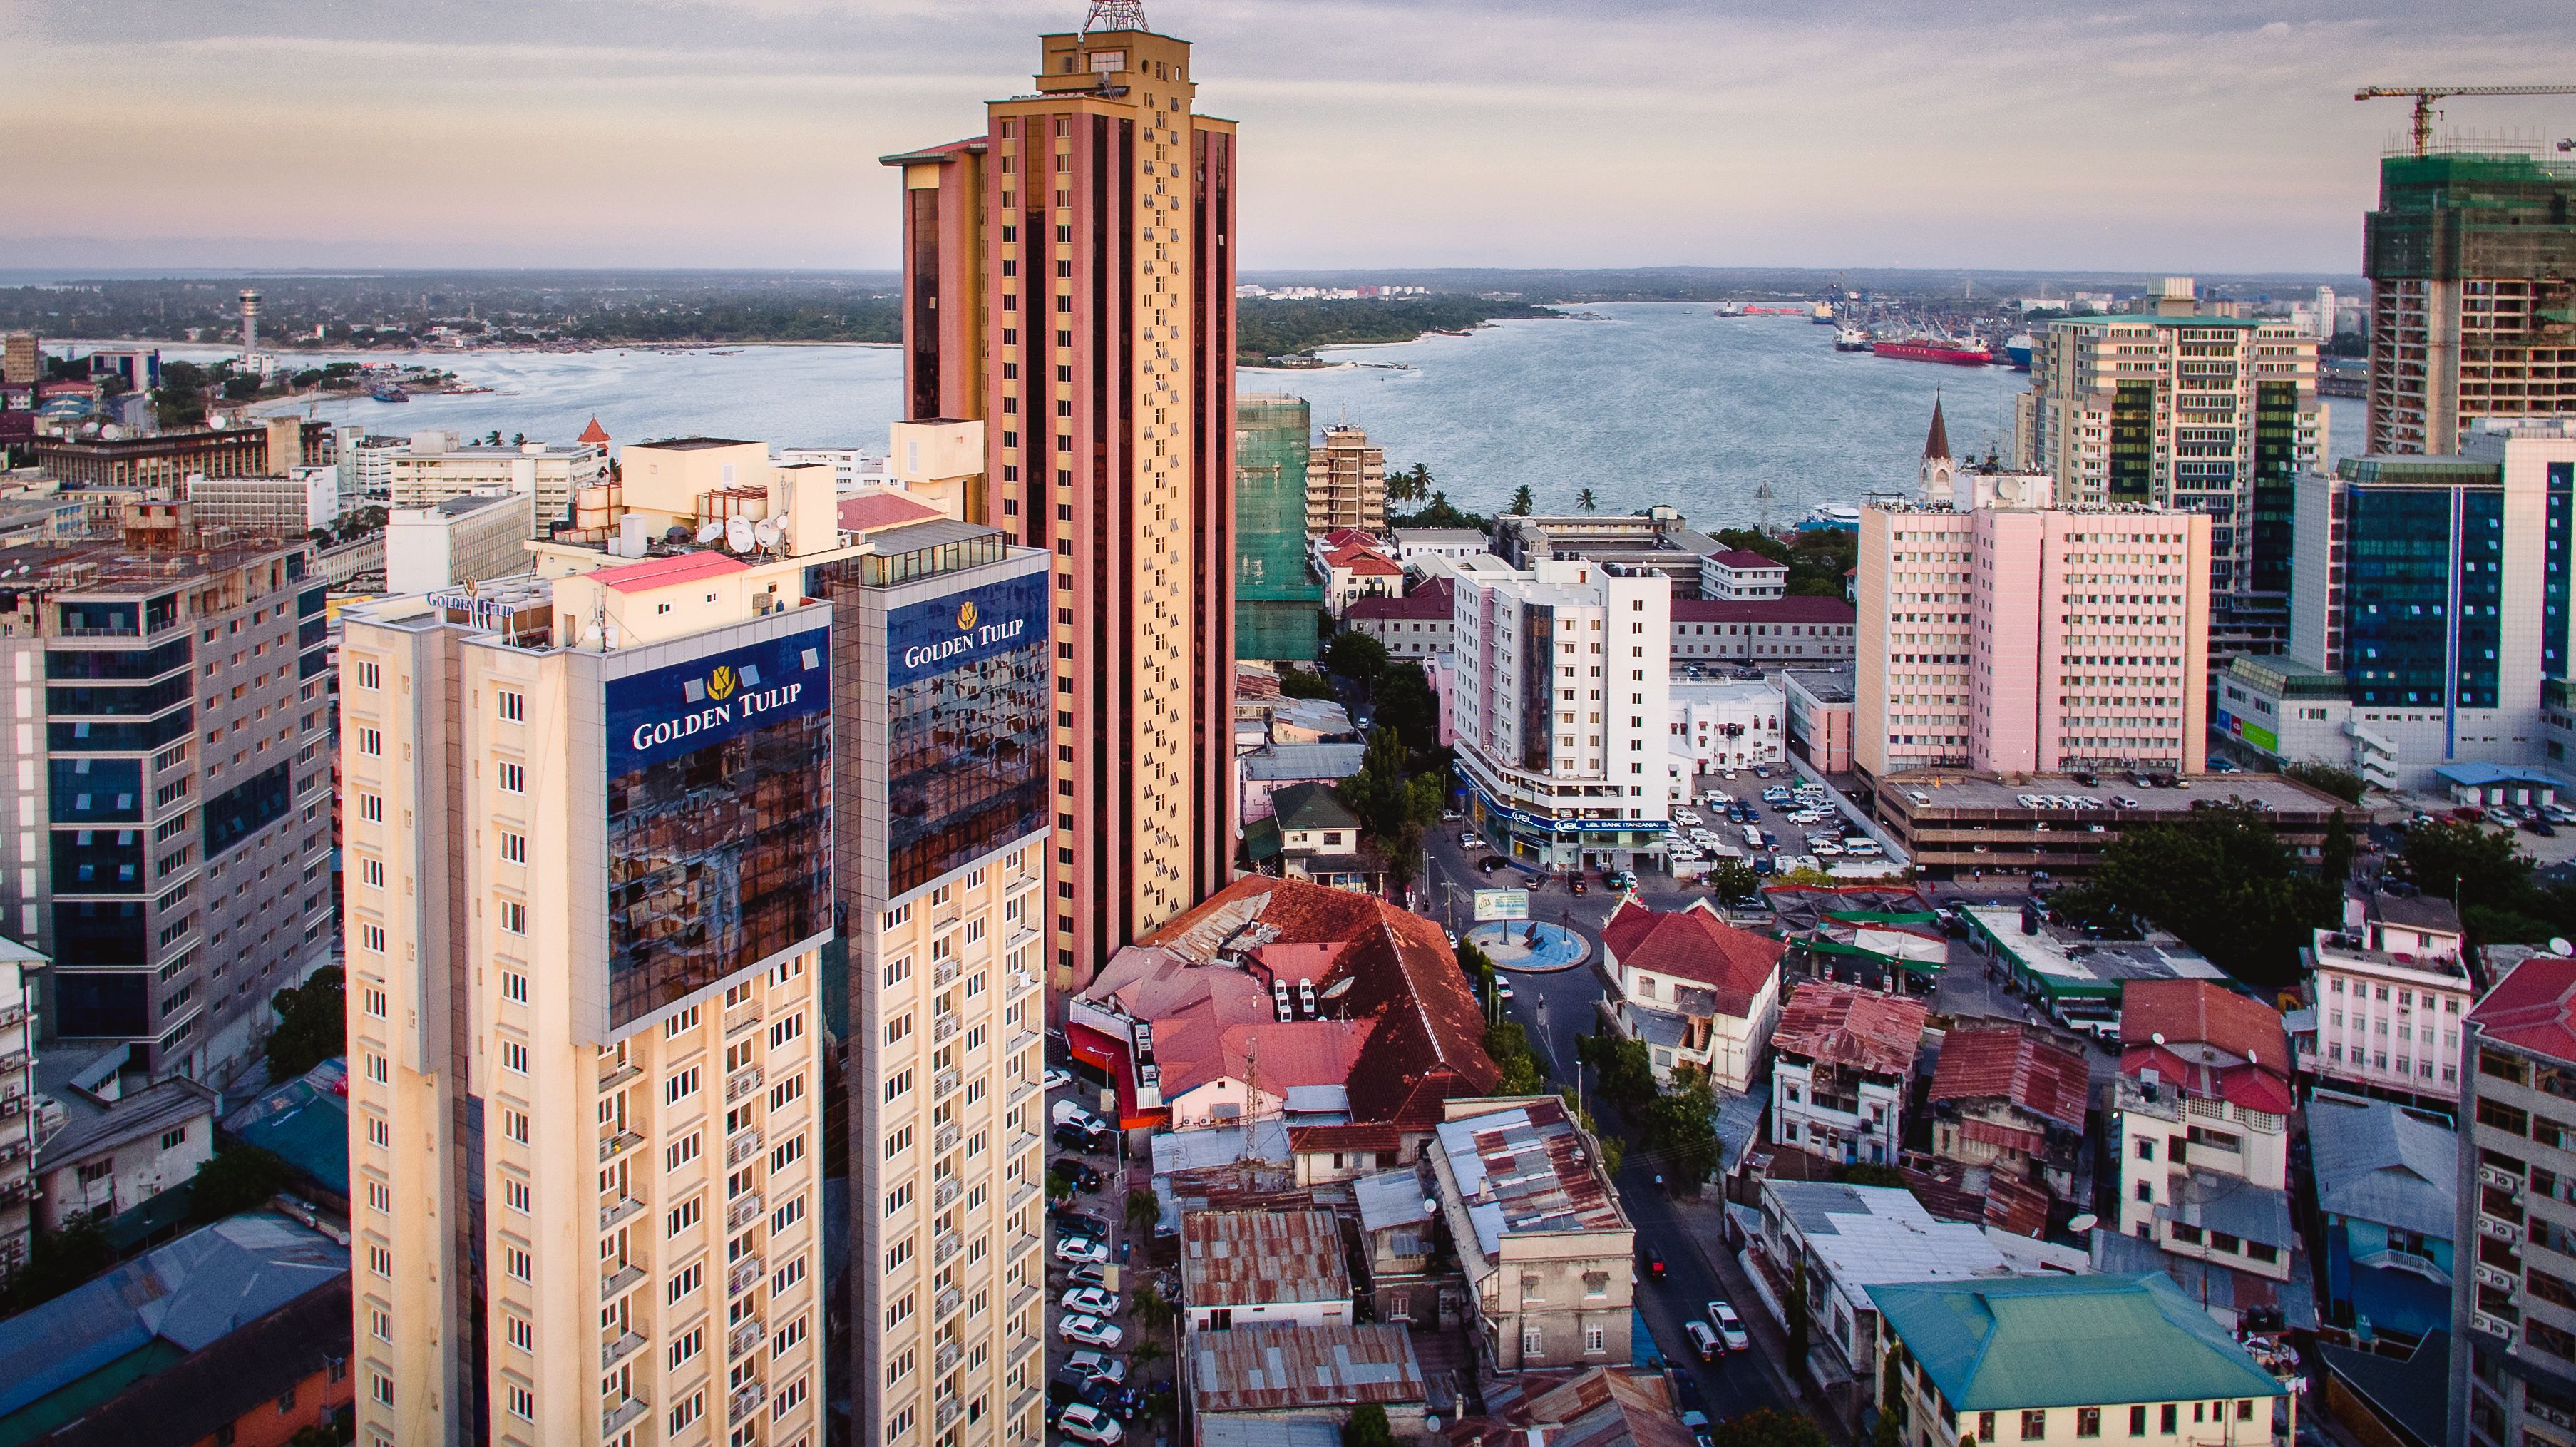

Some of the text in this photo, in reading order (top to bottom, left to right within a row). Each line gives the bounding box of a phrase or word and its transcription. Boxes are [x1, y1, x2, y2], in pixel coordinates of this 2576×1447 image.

[427, 591, 475, 611] GOLDEN
[905, 618, 1024, 668] GOLDEN TULIP
[632, 682, 802, 750] GOLDEN TULIP
[1514, 812, 1534, 824] UBL
